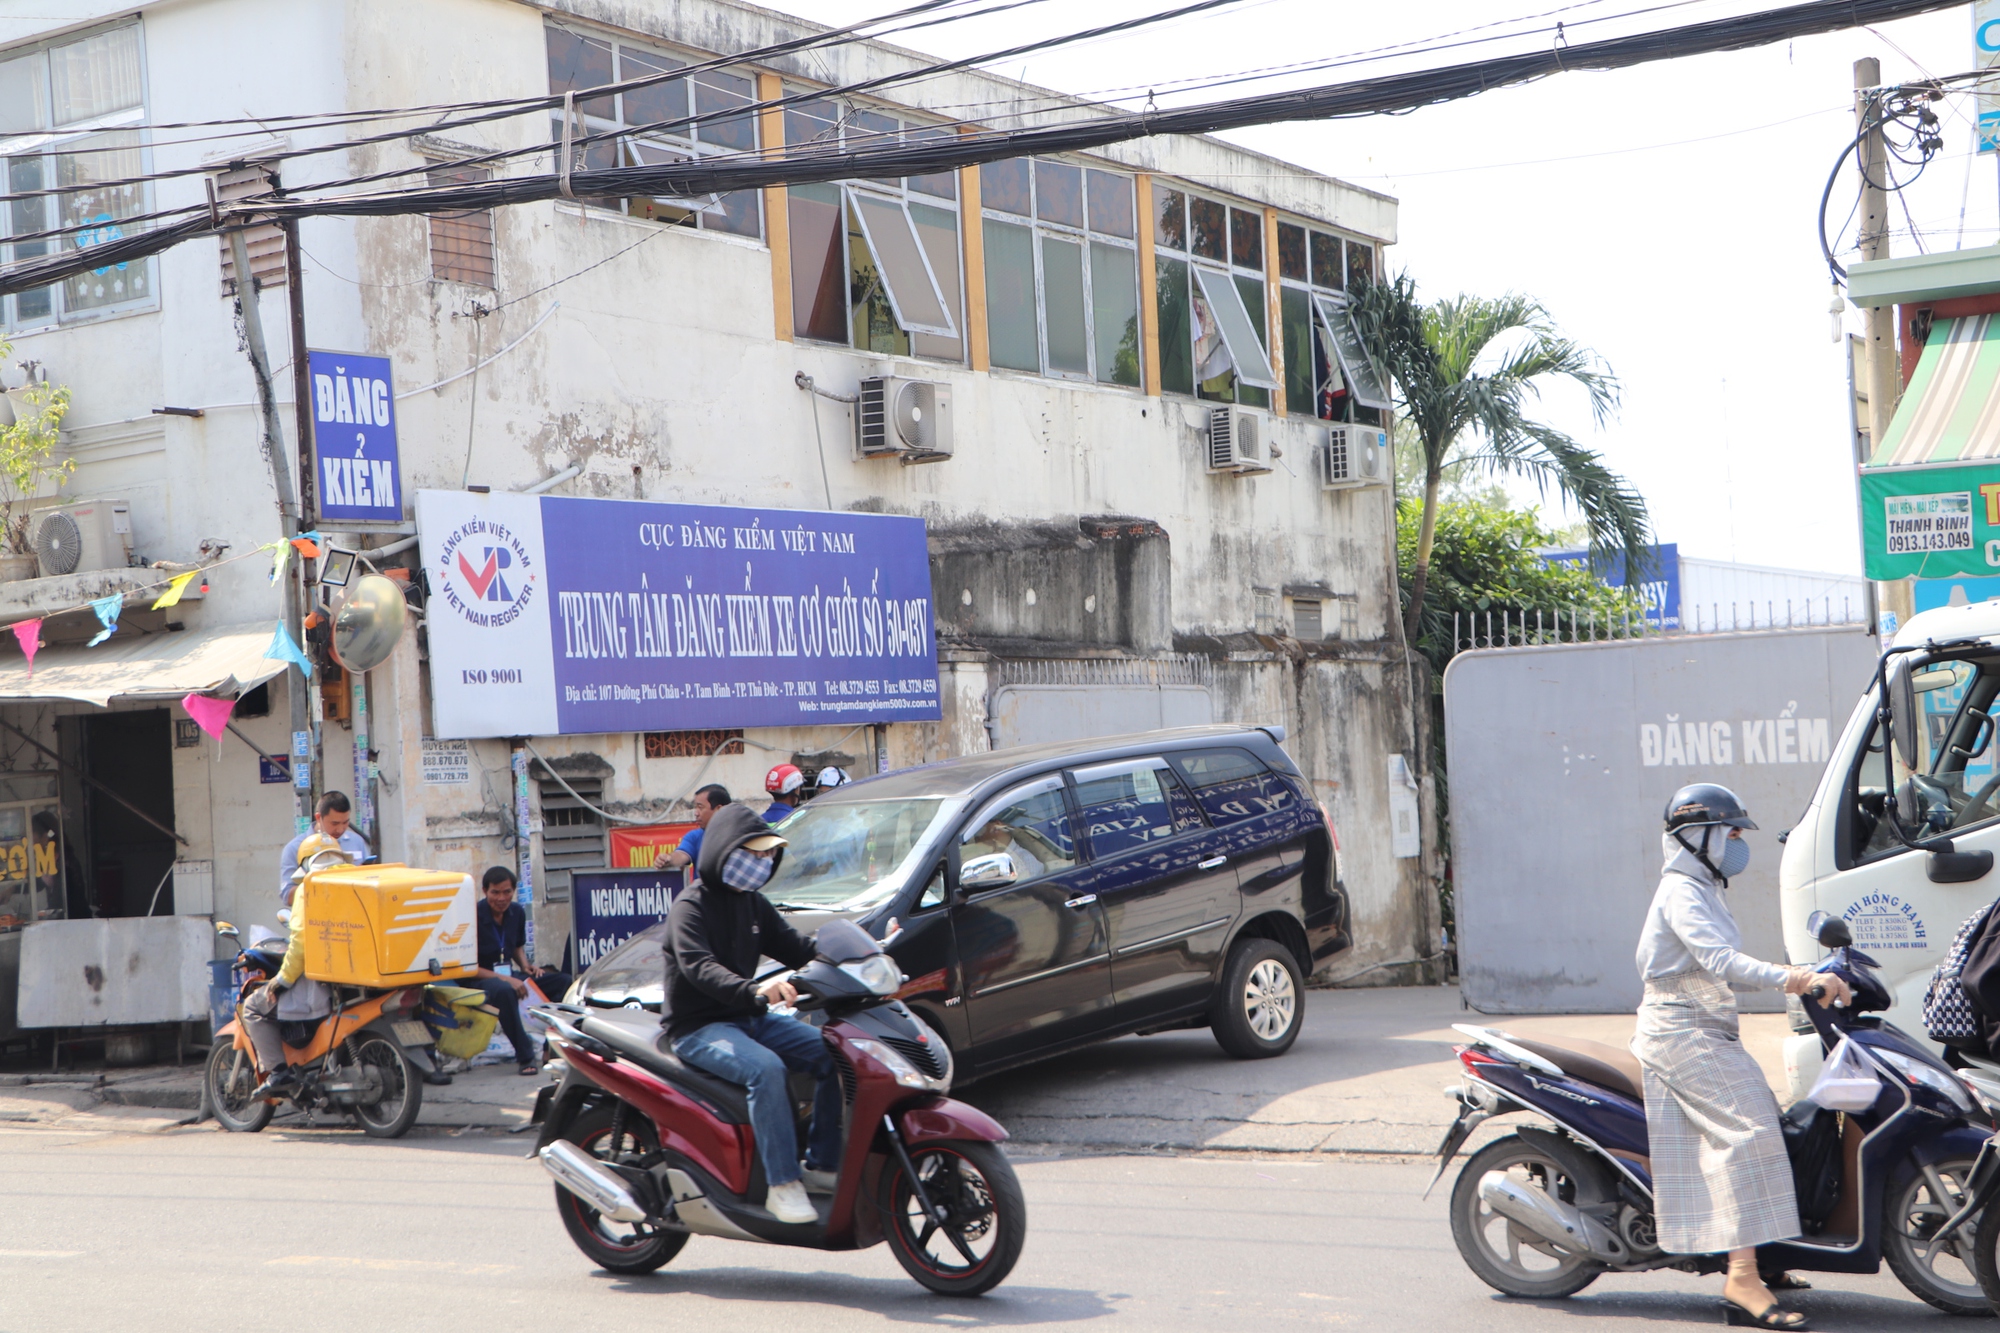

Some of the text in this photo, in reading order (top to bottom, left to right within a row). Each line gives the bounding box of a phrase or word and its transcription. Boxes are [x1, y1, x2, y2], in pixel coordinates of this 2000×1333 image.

[315, 366, 390, 427] ĐĂNG
[323, 432, 395, 507] KIỂM
[440, 515, 531, 568] ĐĂNG KIỂM VIỆT NAM
[639, 517, 855, 556] CỤC ĐĂNG KIỂM VIỆT NAM
[1889, 515, 1969, 533] THANH BÌNH
[1889, 531, 1970, 552] 0913.143.049
[443, 581, 533, 627] VIET NAM REGISTER
[559, 561, 928, 659] TRUNG TÂM ĐĂNG KIỂM XE CƠ GIỚI SỐ 50-03V
[462, 669, 523, 685] ISO 9001
[565, 685, 580, 705] Địa
[582, 683, 597, 701] chỉ:
[599, 684, 612, 701] 107
[613, 684, 641, 704] Đường
[641, 683, 658, 700] Phú
[658, 683, 680, 699] Châu
[694, 682, 712, 699] Tam
[712, 682, 731, 698] Bình
[747, 680, 763, 697] Thủ
[763, 681, 779, 697] Đức
[797, 681, 817, 696] HCM
[824, 681, 839, 695] Tel:
[884, 680, 898, 694] Fax:
[799, 701, 819, 712] Web:
[180, 723, 198, 738] 105
[1640, 700, 1830, 766] ĐĂNG KIỂM
[637, 881, 673, 922] NHẬN
[1862, 888, 1899, 906] HỒNG
[1873, 906, 1887, 914] 3N
[579, 929, 597, 965] HỒ
